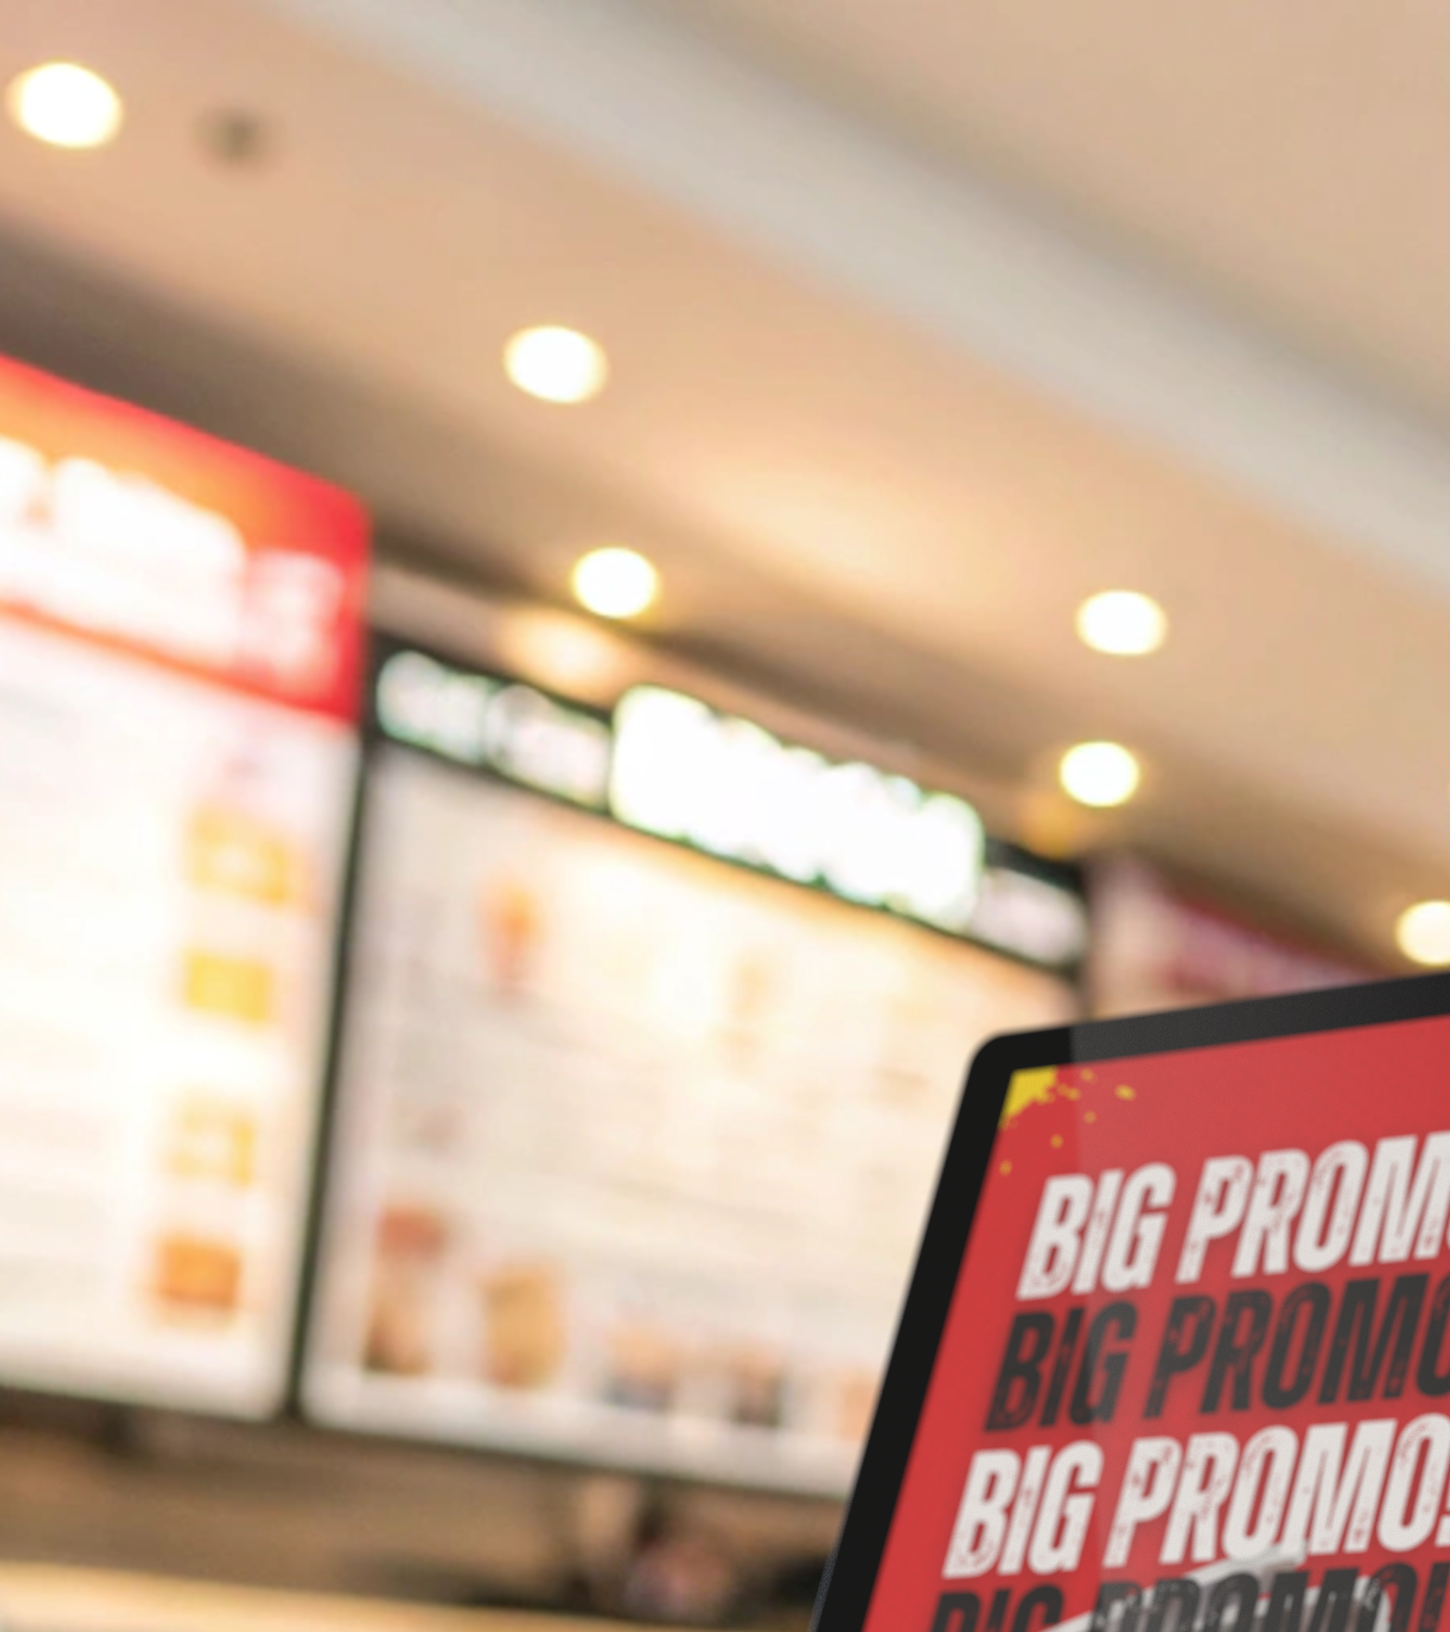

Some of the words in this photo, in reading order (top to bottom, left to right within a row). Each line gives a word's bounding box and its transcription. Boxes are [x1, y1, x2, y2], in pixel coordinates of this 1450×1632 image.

[1016, 1163, 1177, 1299] BIG
[984, 1301, 1139, 1432] BIG
[942, 1440, 1104, 1579] BIG
